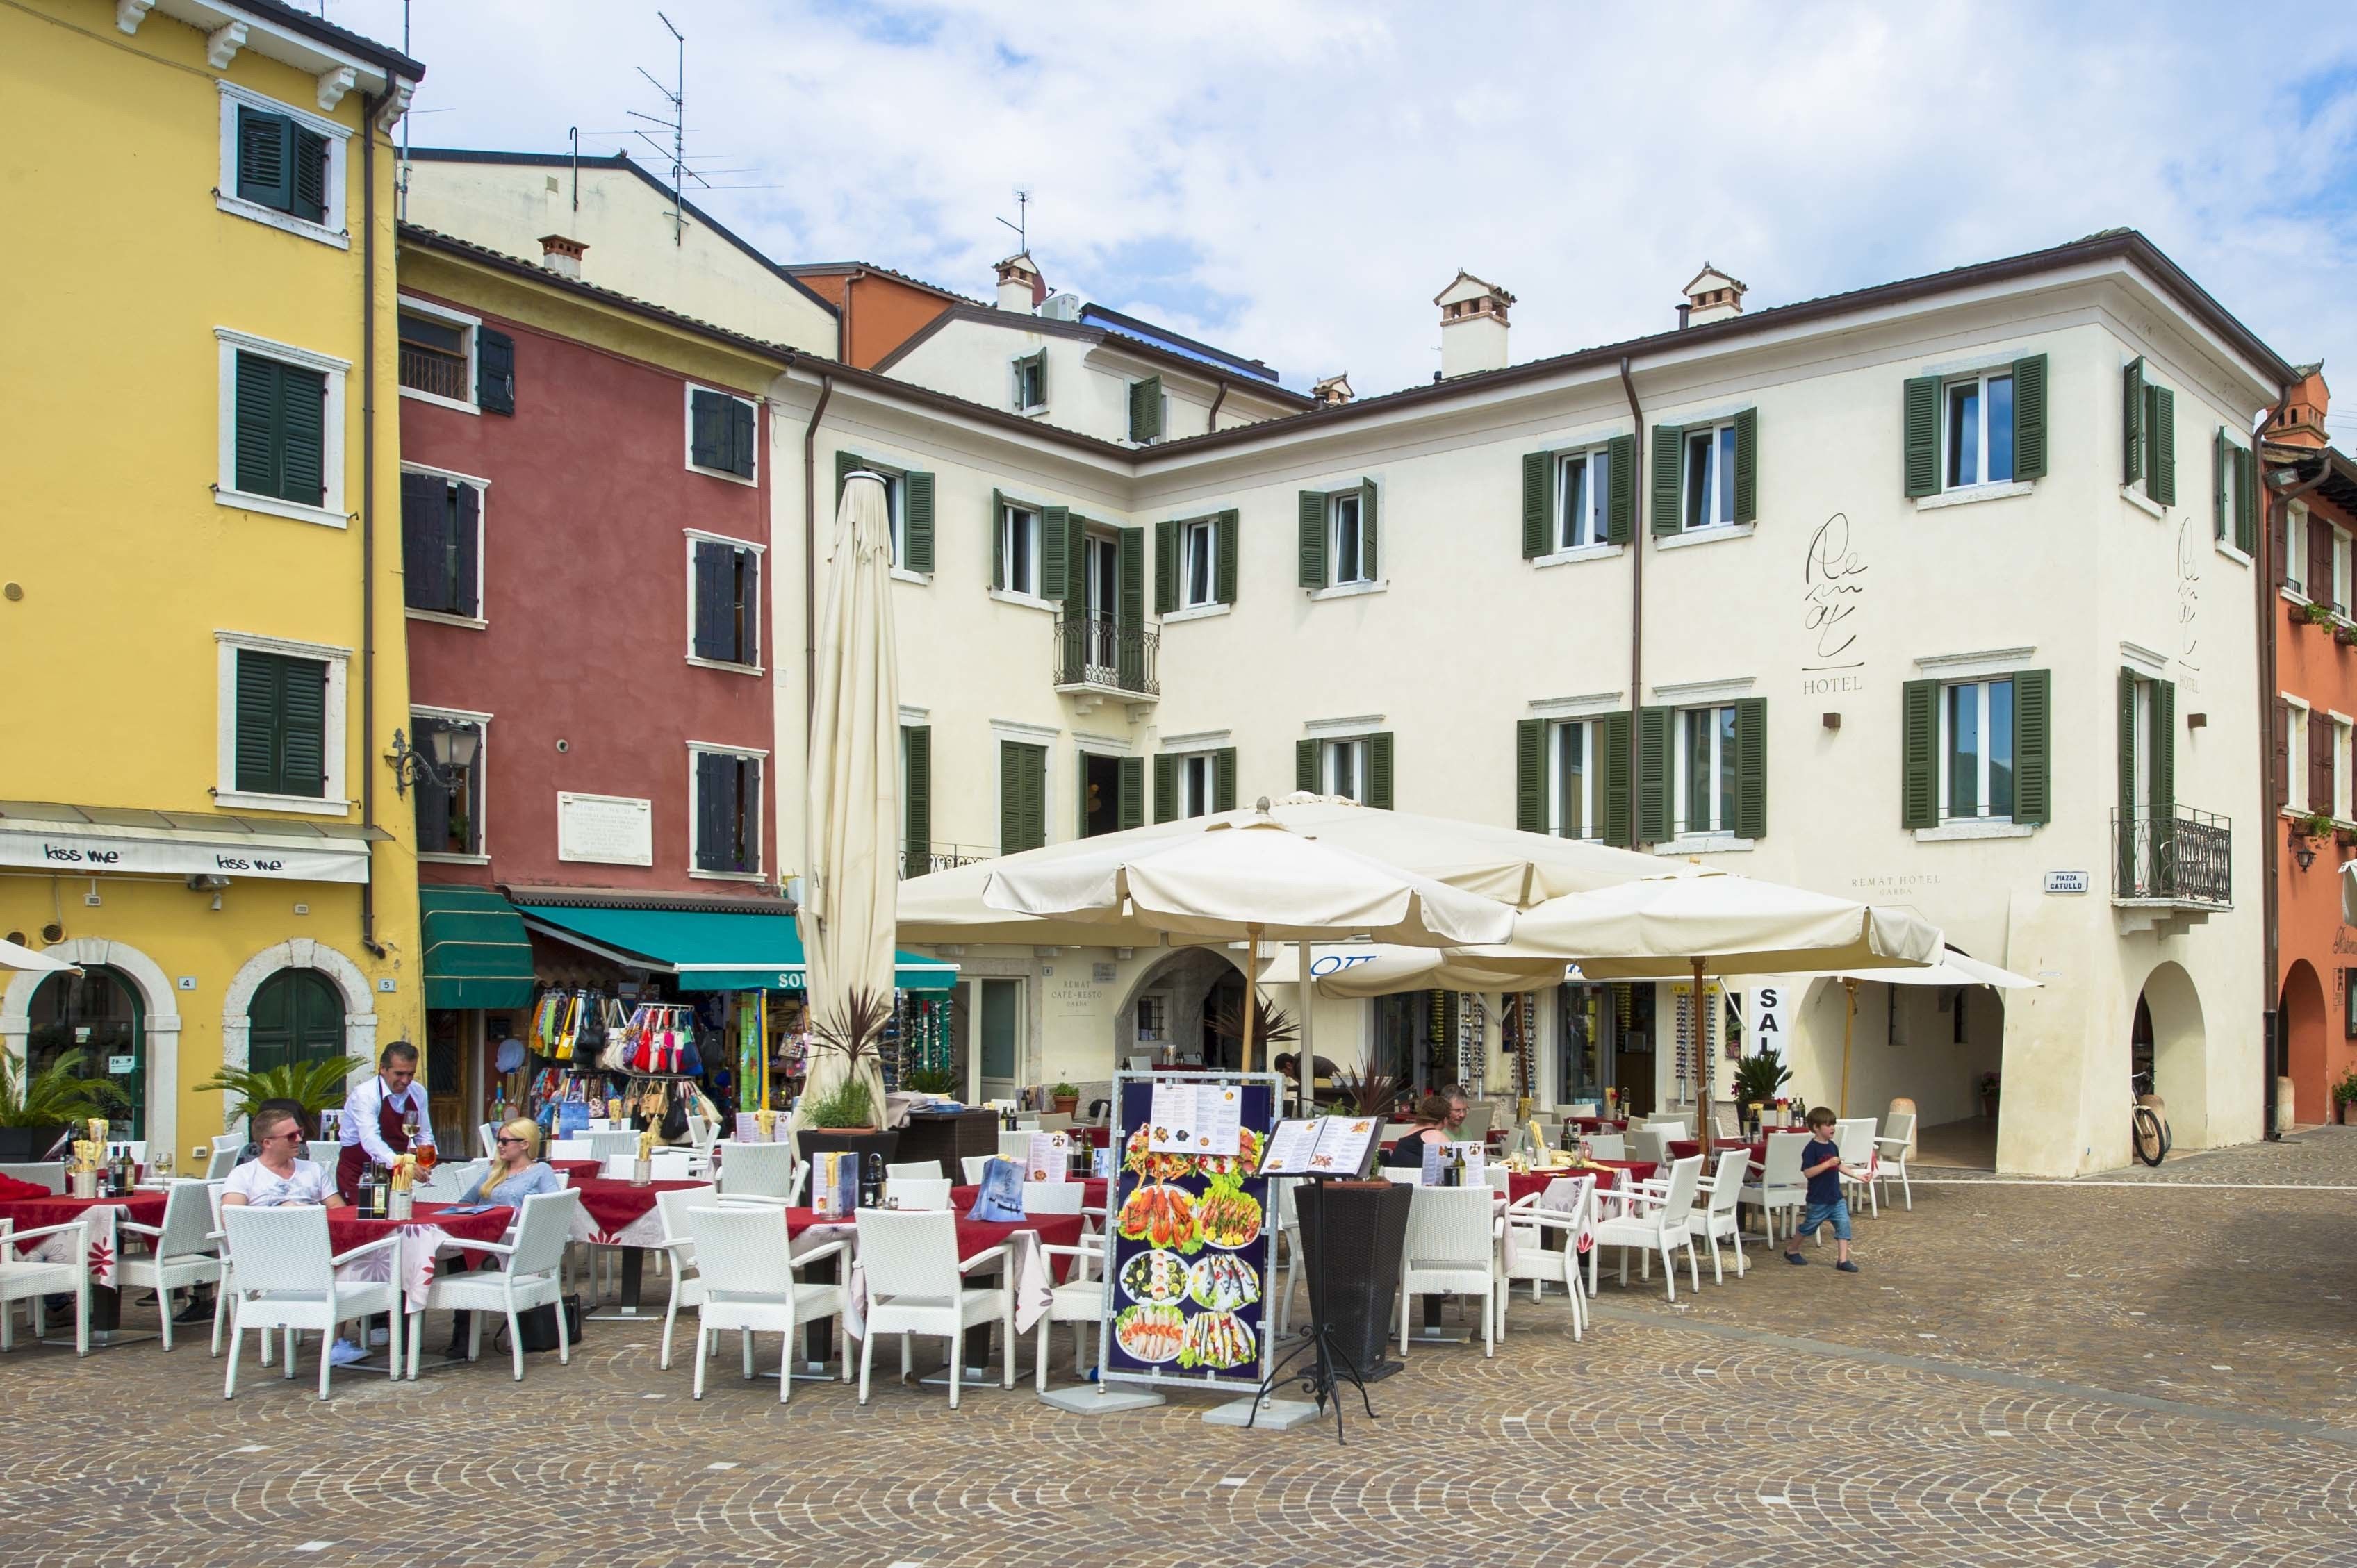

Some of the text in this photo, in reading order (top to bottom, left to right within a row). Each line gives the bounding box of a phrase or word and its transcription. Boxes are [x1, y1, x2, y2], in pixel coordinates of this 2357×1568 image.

[1803, 676, 1863, 695] HOTEL
[2178, 673, 2201, 694] HOTEL
[44, 843, 120, 864] kiss me
[216, 854, 284, 871] kiss me
[1899, 874, 1941, 884] HOTEL
